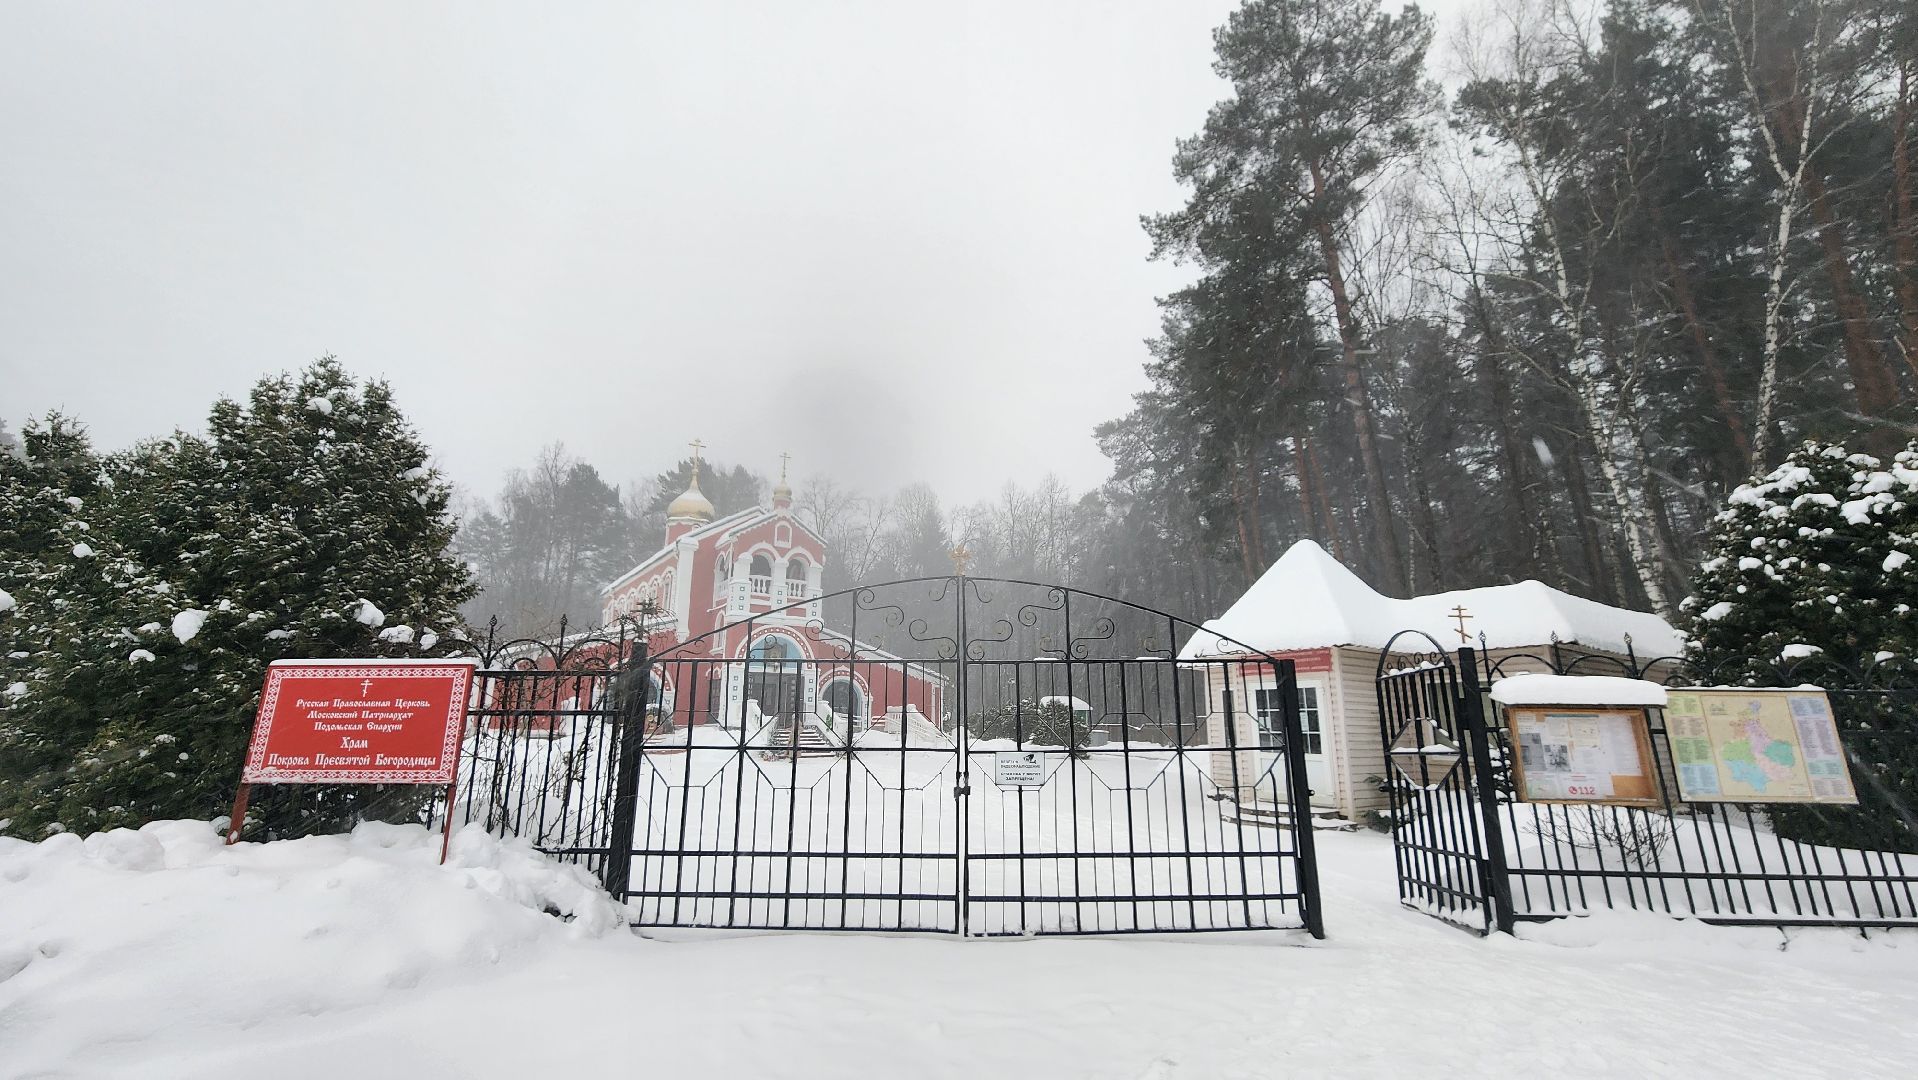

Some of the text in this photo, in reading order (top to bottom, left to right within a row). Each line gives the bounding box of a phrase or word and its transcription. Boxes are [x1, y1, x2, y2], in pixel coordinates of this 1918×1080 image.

[295, 698, 431, 710] Русская Православная Церковь
[306, 710, 414, 721] Московский Патриархат
[314, 721, 363, 732] Подольская
[340, 736, 369, 752] Храм
[267, 753, 437, 769] Покрова Пресвятой Богородицы
[1579, 786, 1596, 796] 112
